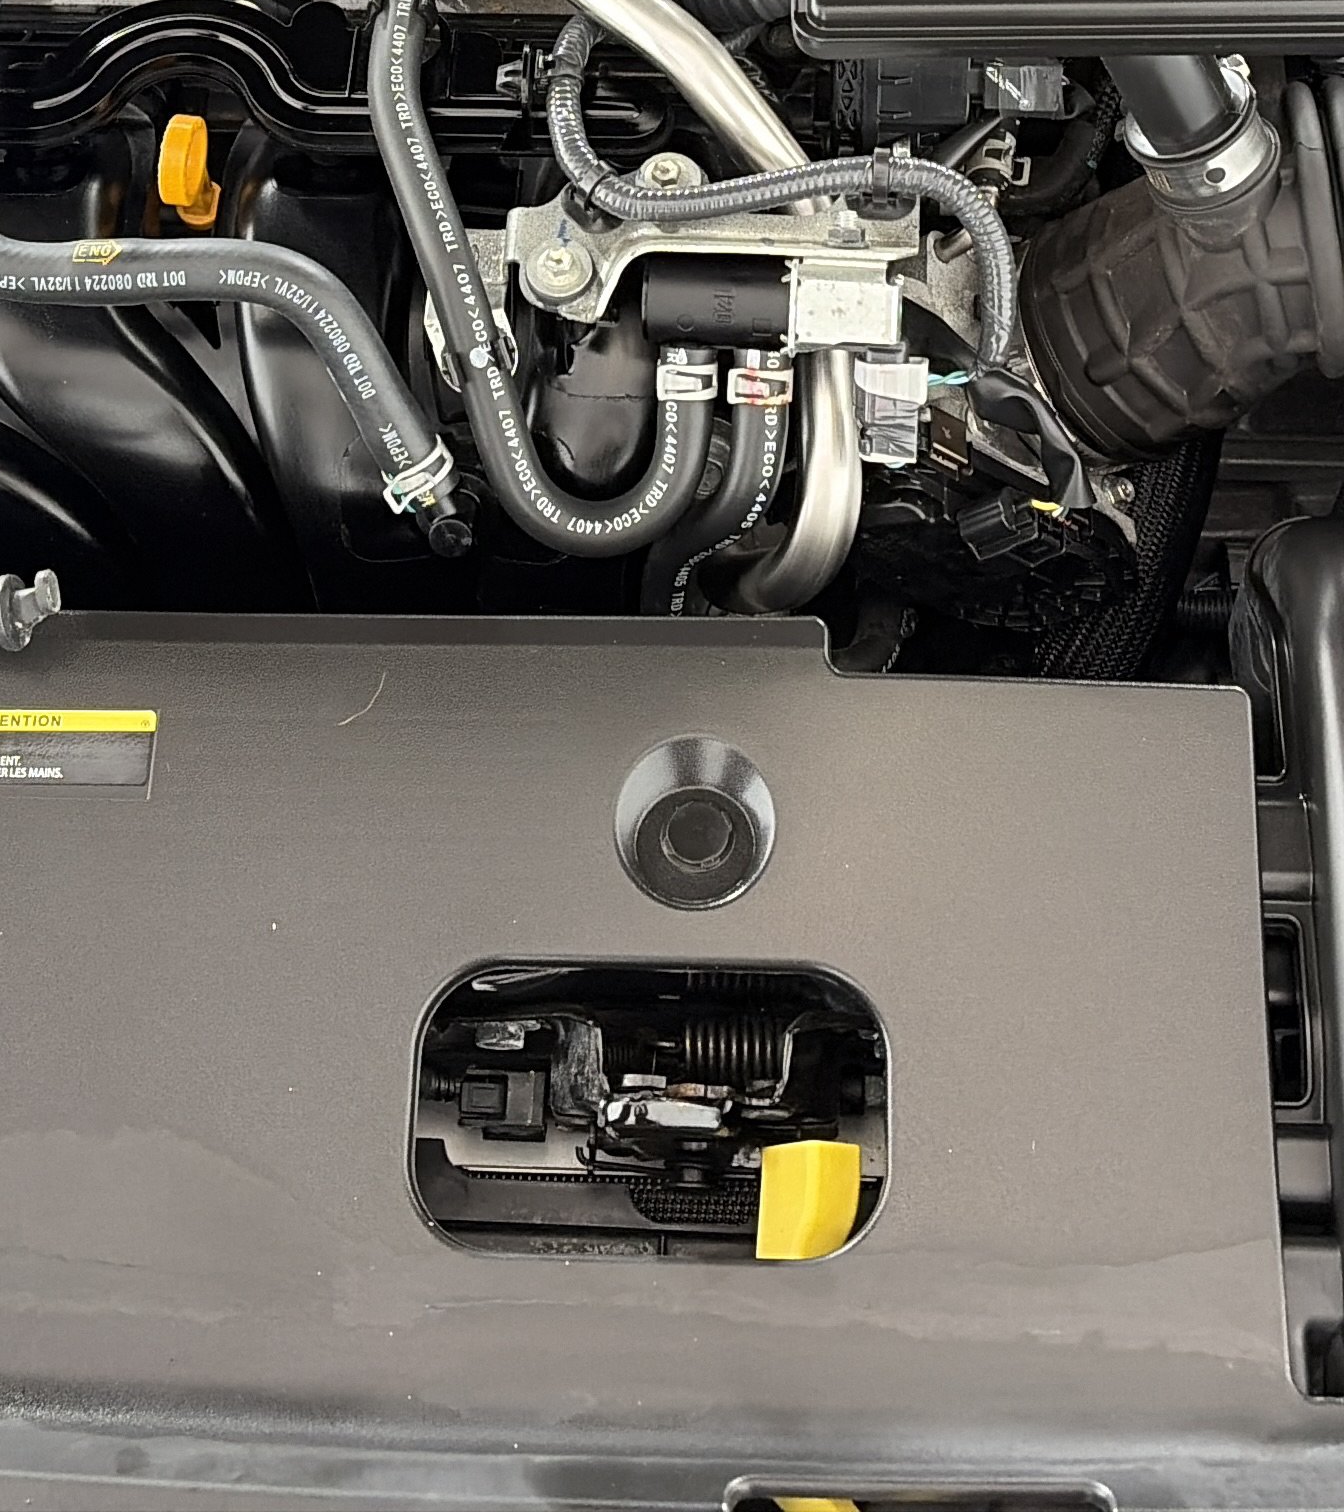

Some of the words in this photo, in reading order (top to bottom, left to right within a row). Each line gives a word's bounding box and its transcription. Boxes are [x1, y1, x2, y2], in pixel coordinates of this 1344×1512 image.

[78, 244, 112, 258] ENG
[163, 270, 186, 286] DOT
[356, 377, 377, 400] DOT
[9, 767, 27, 777] LES
[28, 767, 64, 778] MAINS.
